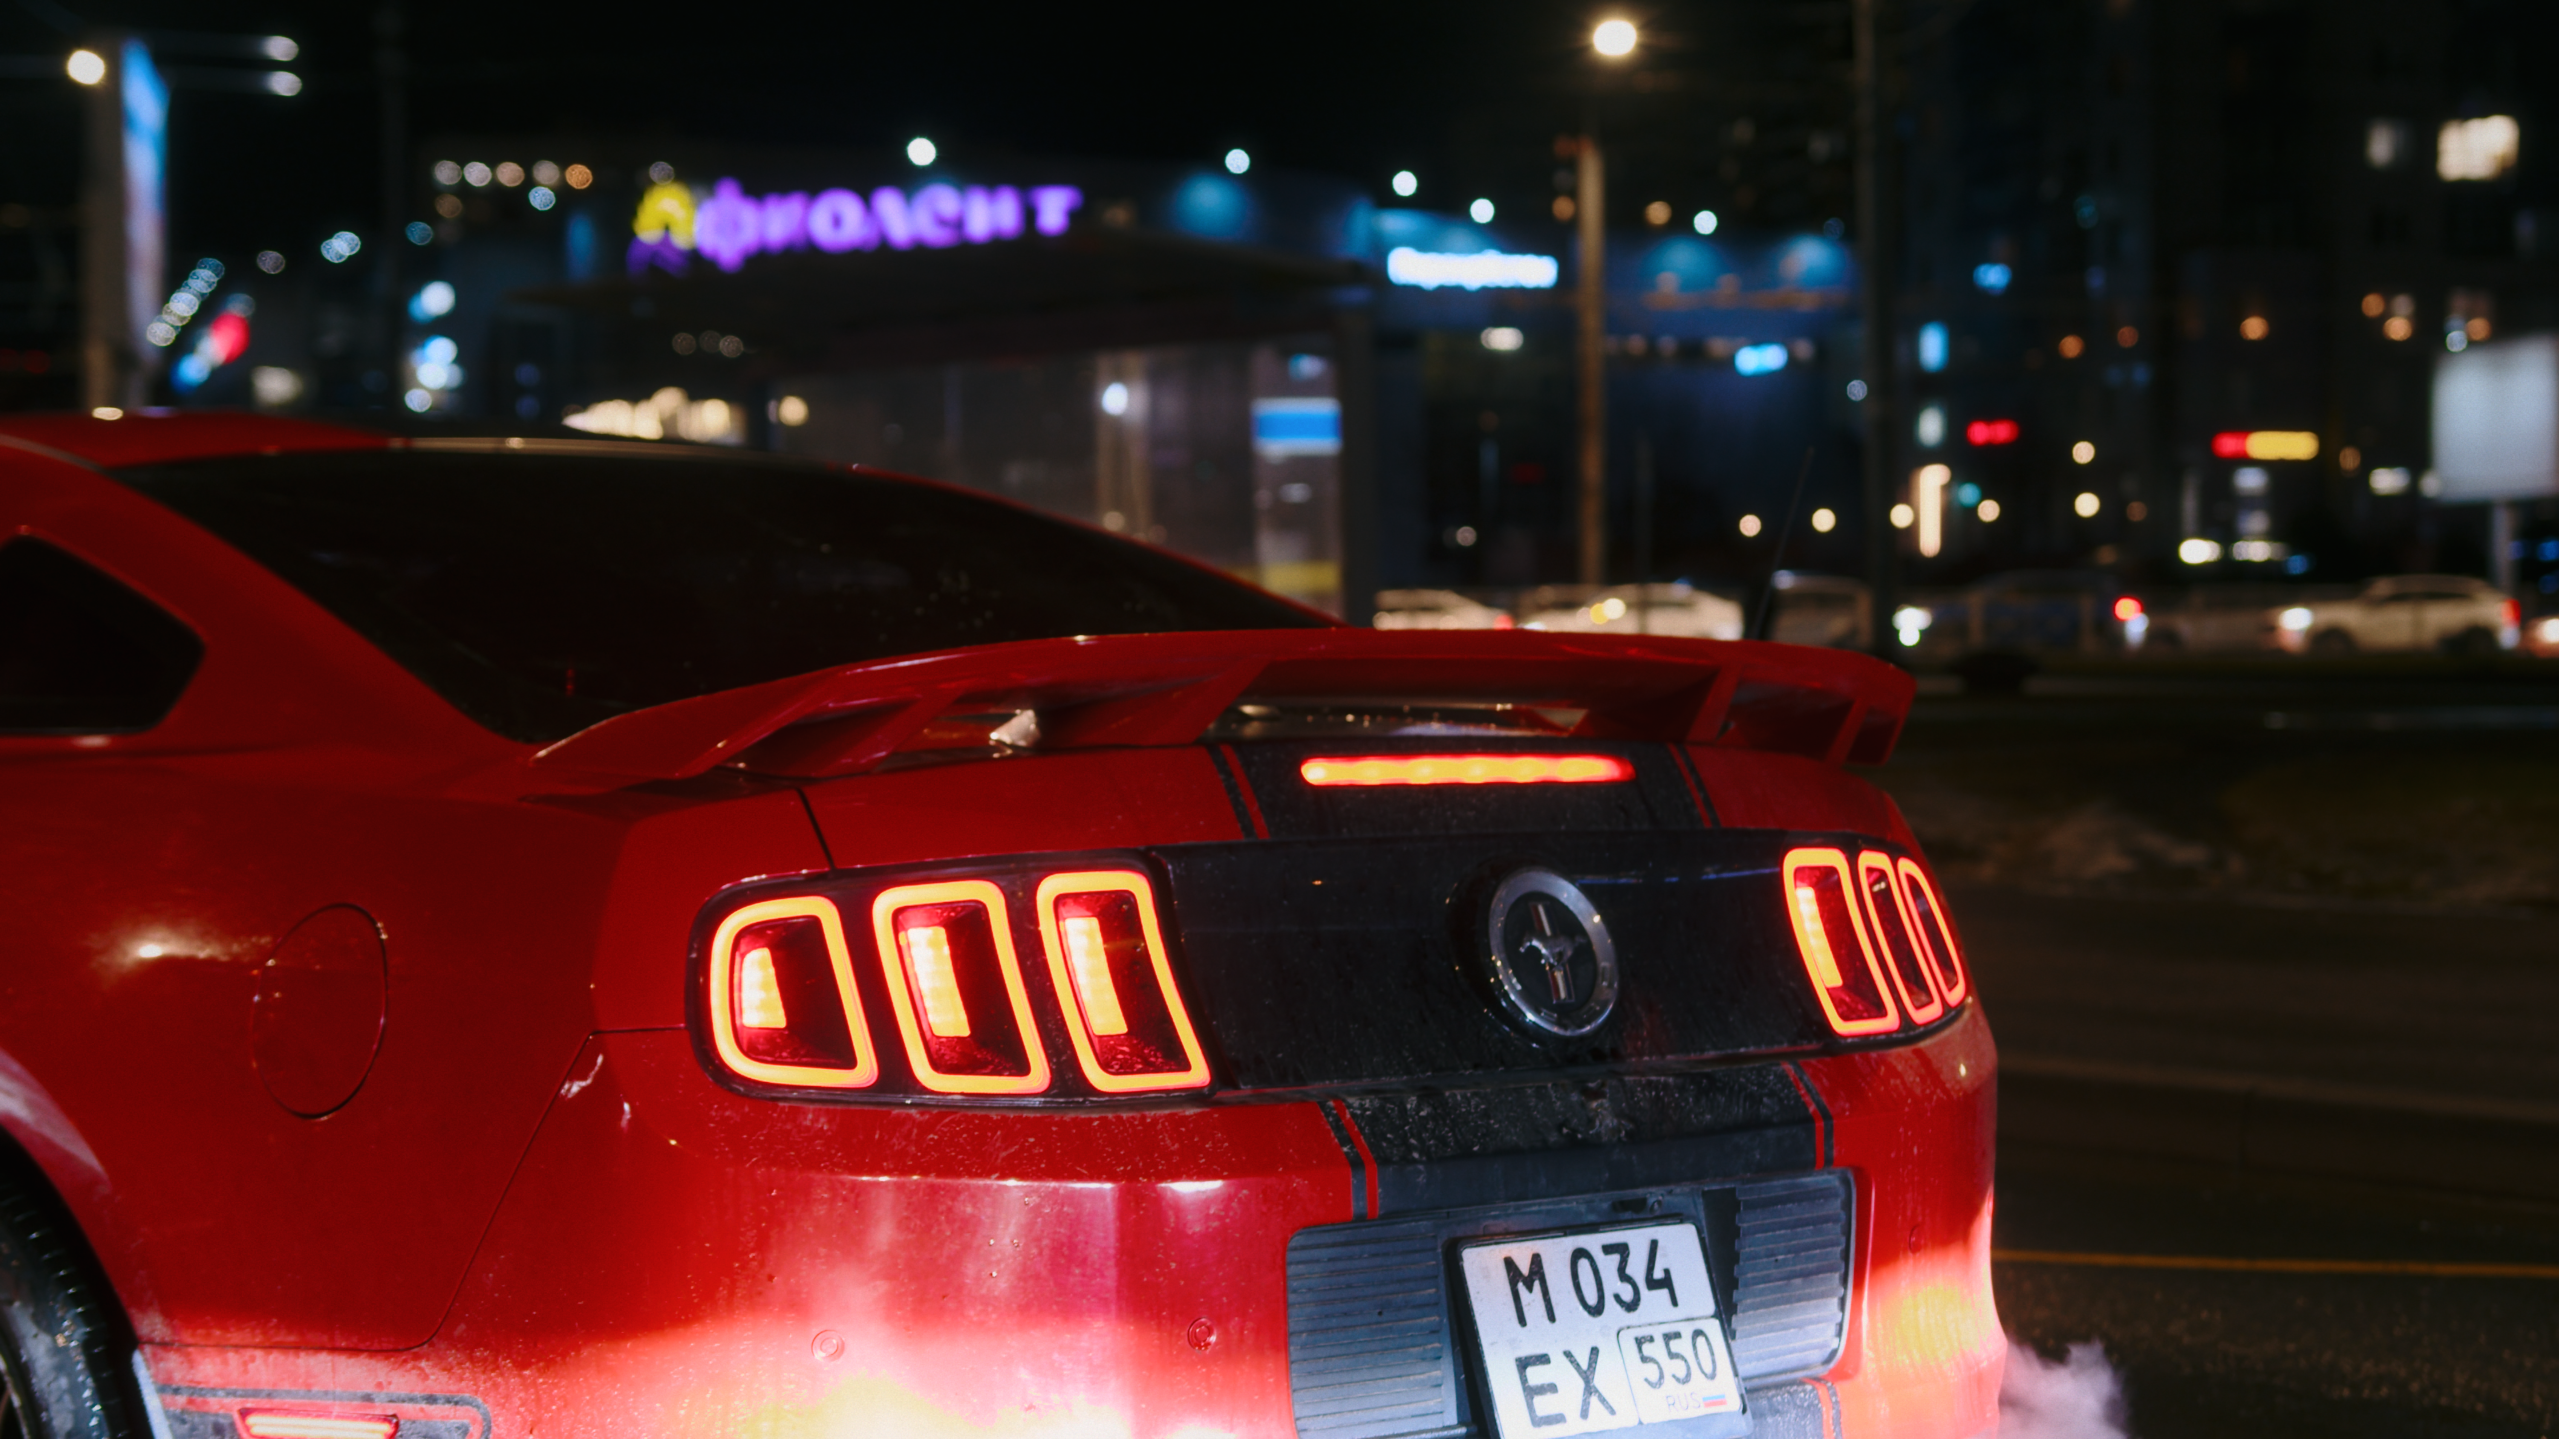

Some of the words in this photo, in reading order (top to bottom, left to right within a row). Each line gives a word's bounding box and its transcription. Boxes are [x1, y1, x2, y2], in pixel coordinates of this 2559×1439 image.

[1503, 1252, 1557, 1328] M
[1569, 1239, 1679, 1318] 034
[1514, 1346, 1617, 1428] EX
[1634, 1328, 1718, 1389] 550
[1665, 1390, 1702, 1413] RUS
